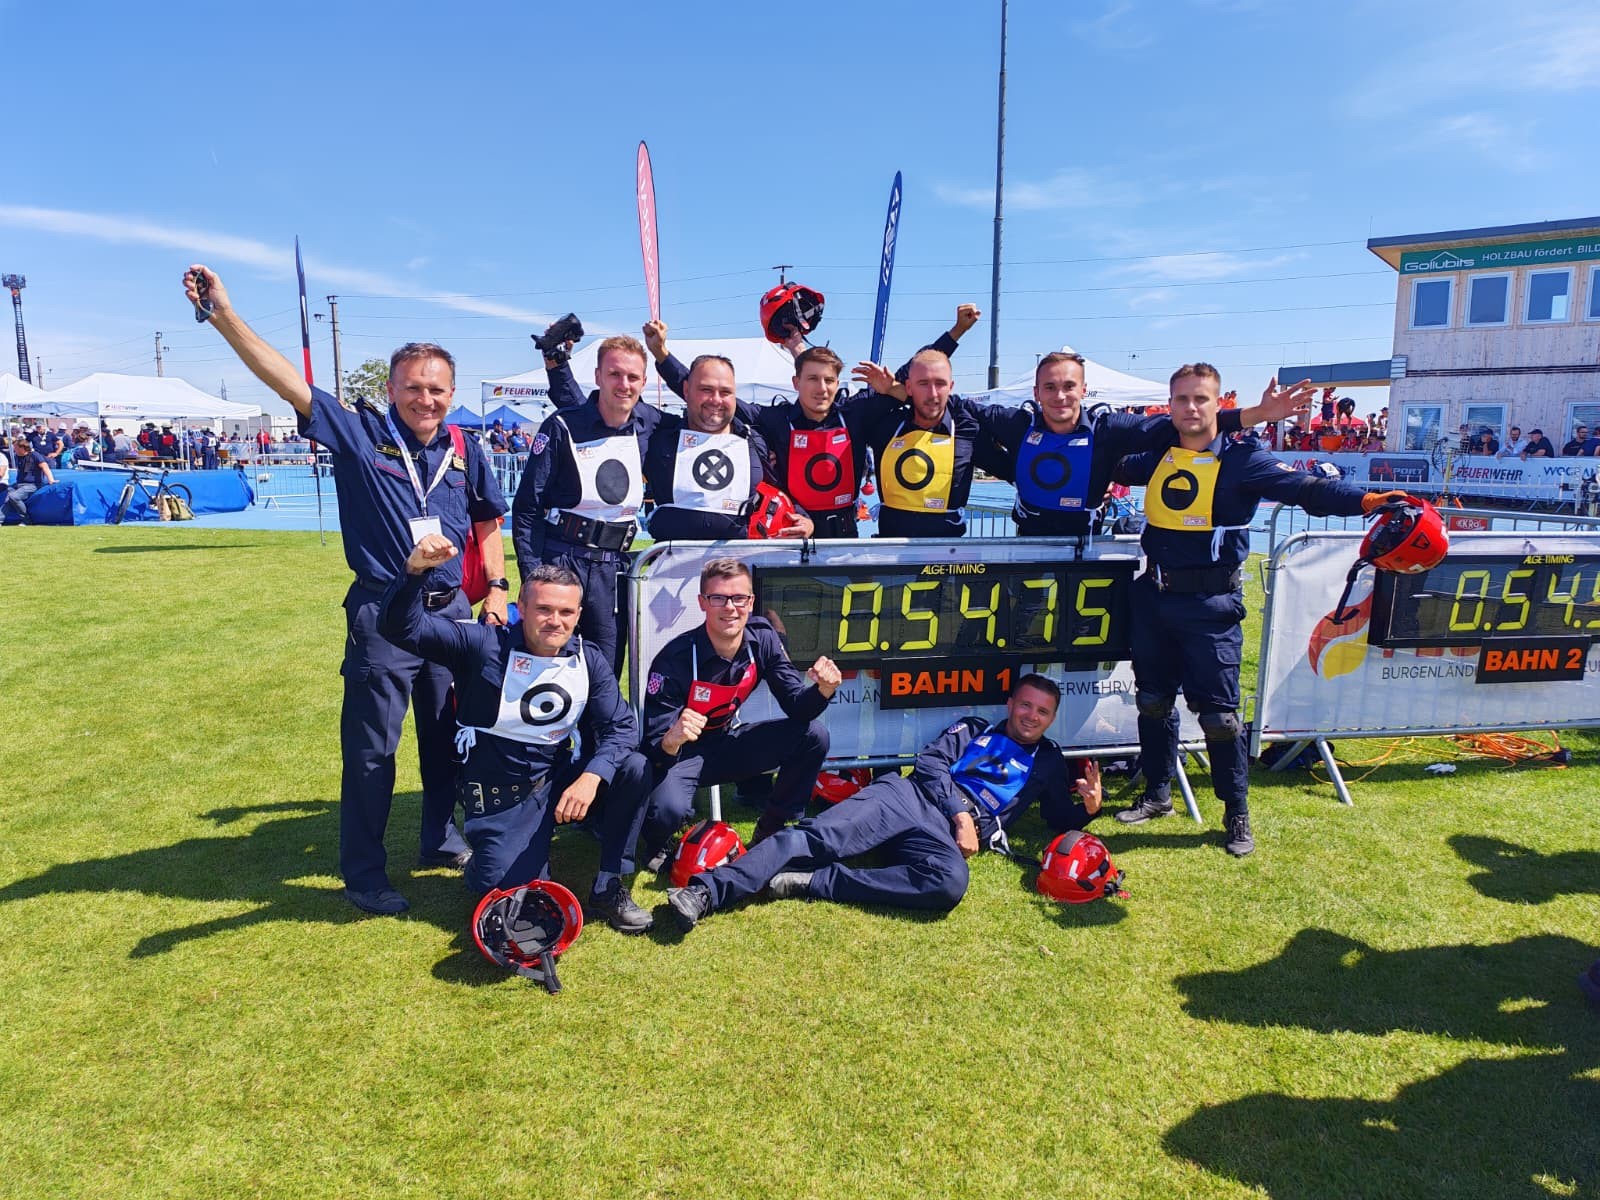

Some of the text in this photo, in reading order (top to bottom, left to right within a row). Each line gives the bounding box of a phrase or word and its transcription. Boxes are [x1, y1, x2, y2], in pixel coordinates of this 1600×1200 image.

[1482, 250, 1532, 261] HOLZBAU
[1534, 247, 1573, 257] fördert
[1457, 467, 1523, 481] FEUERWEHR
[920, 564, 986, 575] ALGE-TIMING
[838, 578, 1114, 652] 0.54.75
[1485, 650, 1559, 671] BAHN
[1564, 648, 1583, 669] 2
[1382, 664, 1475, 680] BURGENLÄND
[890, 669, 984, 696] BAHN
[996, 668, 1011, 692] 1
[1058, 680, 1138, 696] ERWEHRV
